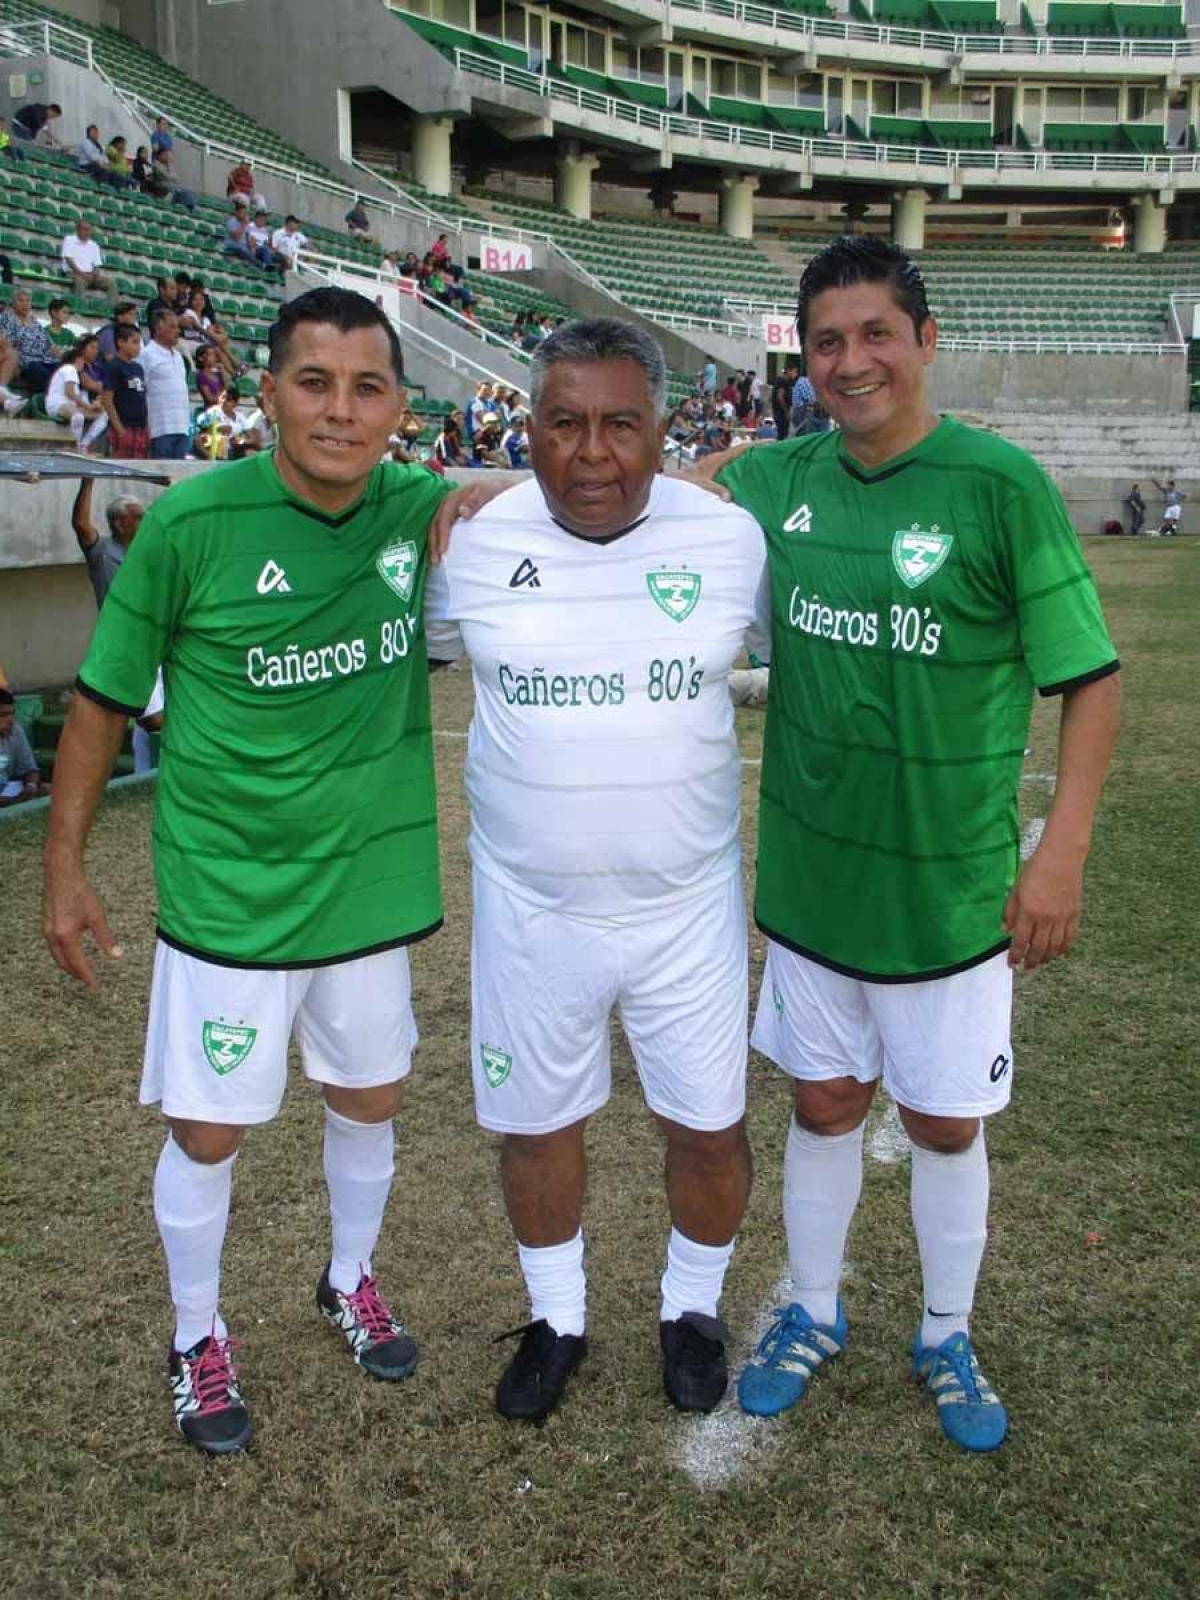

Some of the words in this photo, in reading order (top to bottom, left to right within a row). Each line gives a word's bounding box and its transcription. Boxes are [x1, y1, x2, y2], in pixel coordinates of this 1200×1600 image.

[767, 323, 795, 347] B1
[247, 639, 367, 687] Cañeros
[380, 612, 417, 664] 80'
[499, 664, 626, 707] Cañeros
[647, 655, 705, 702] 80's
